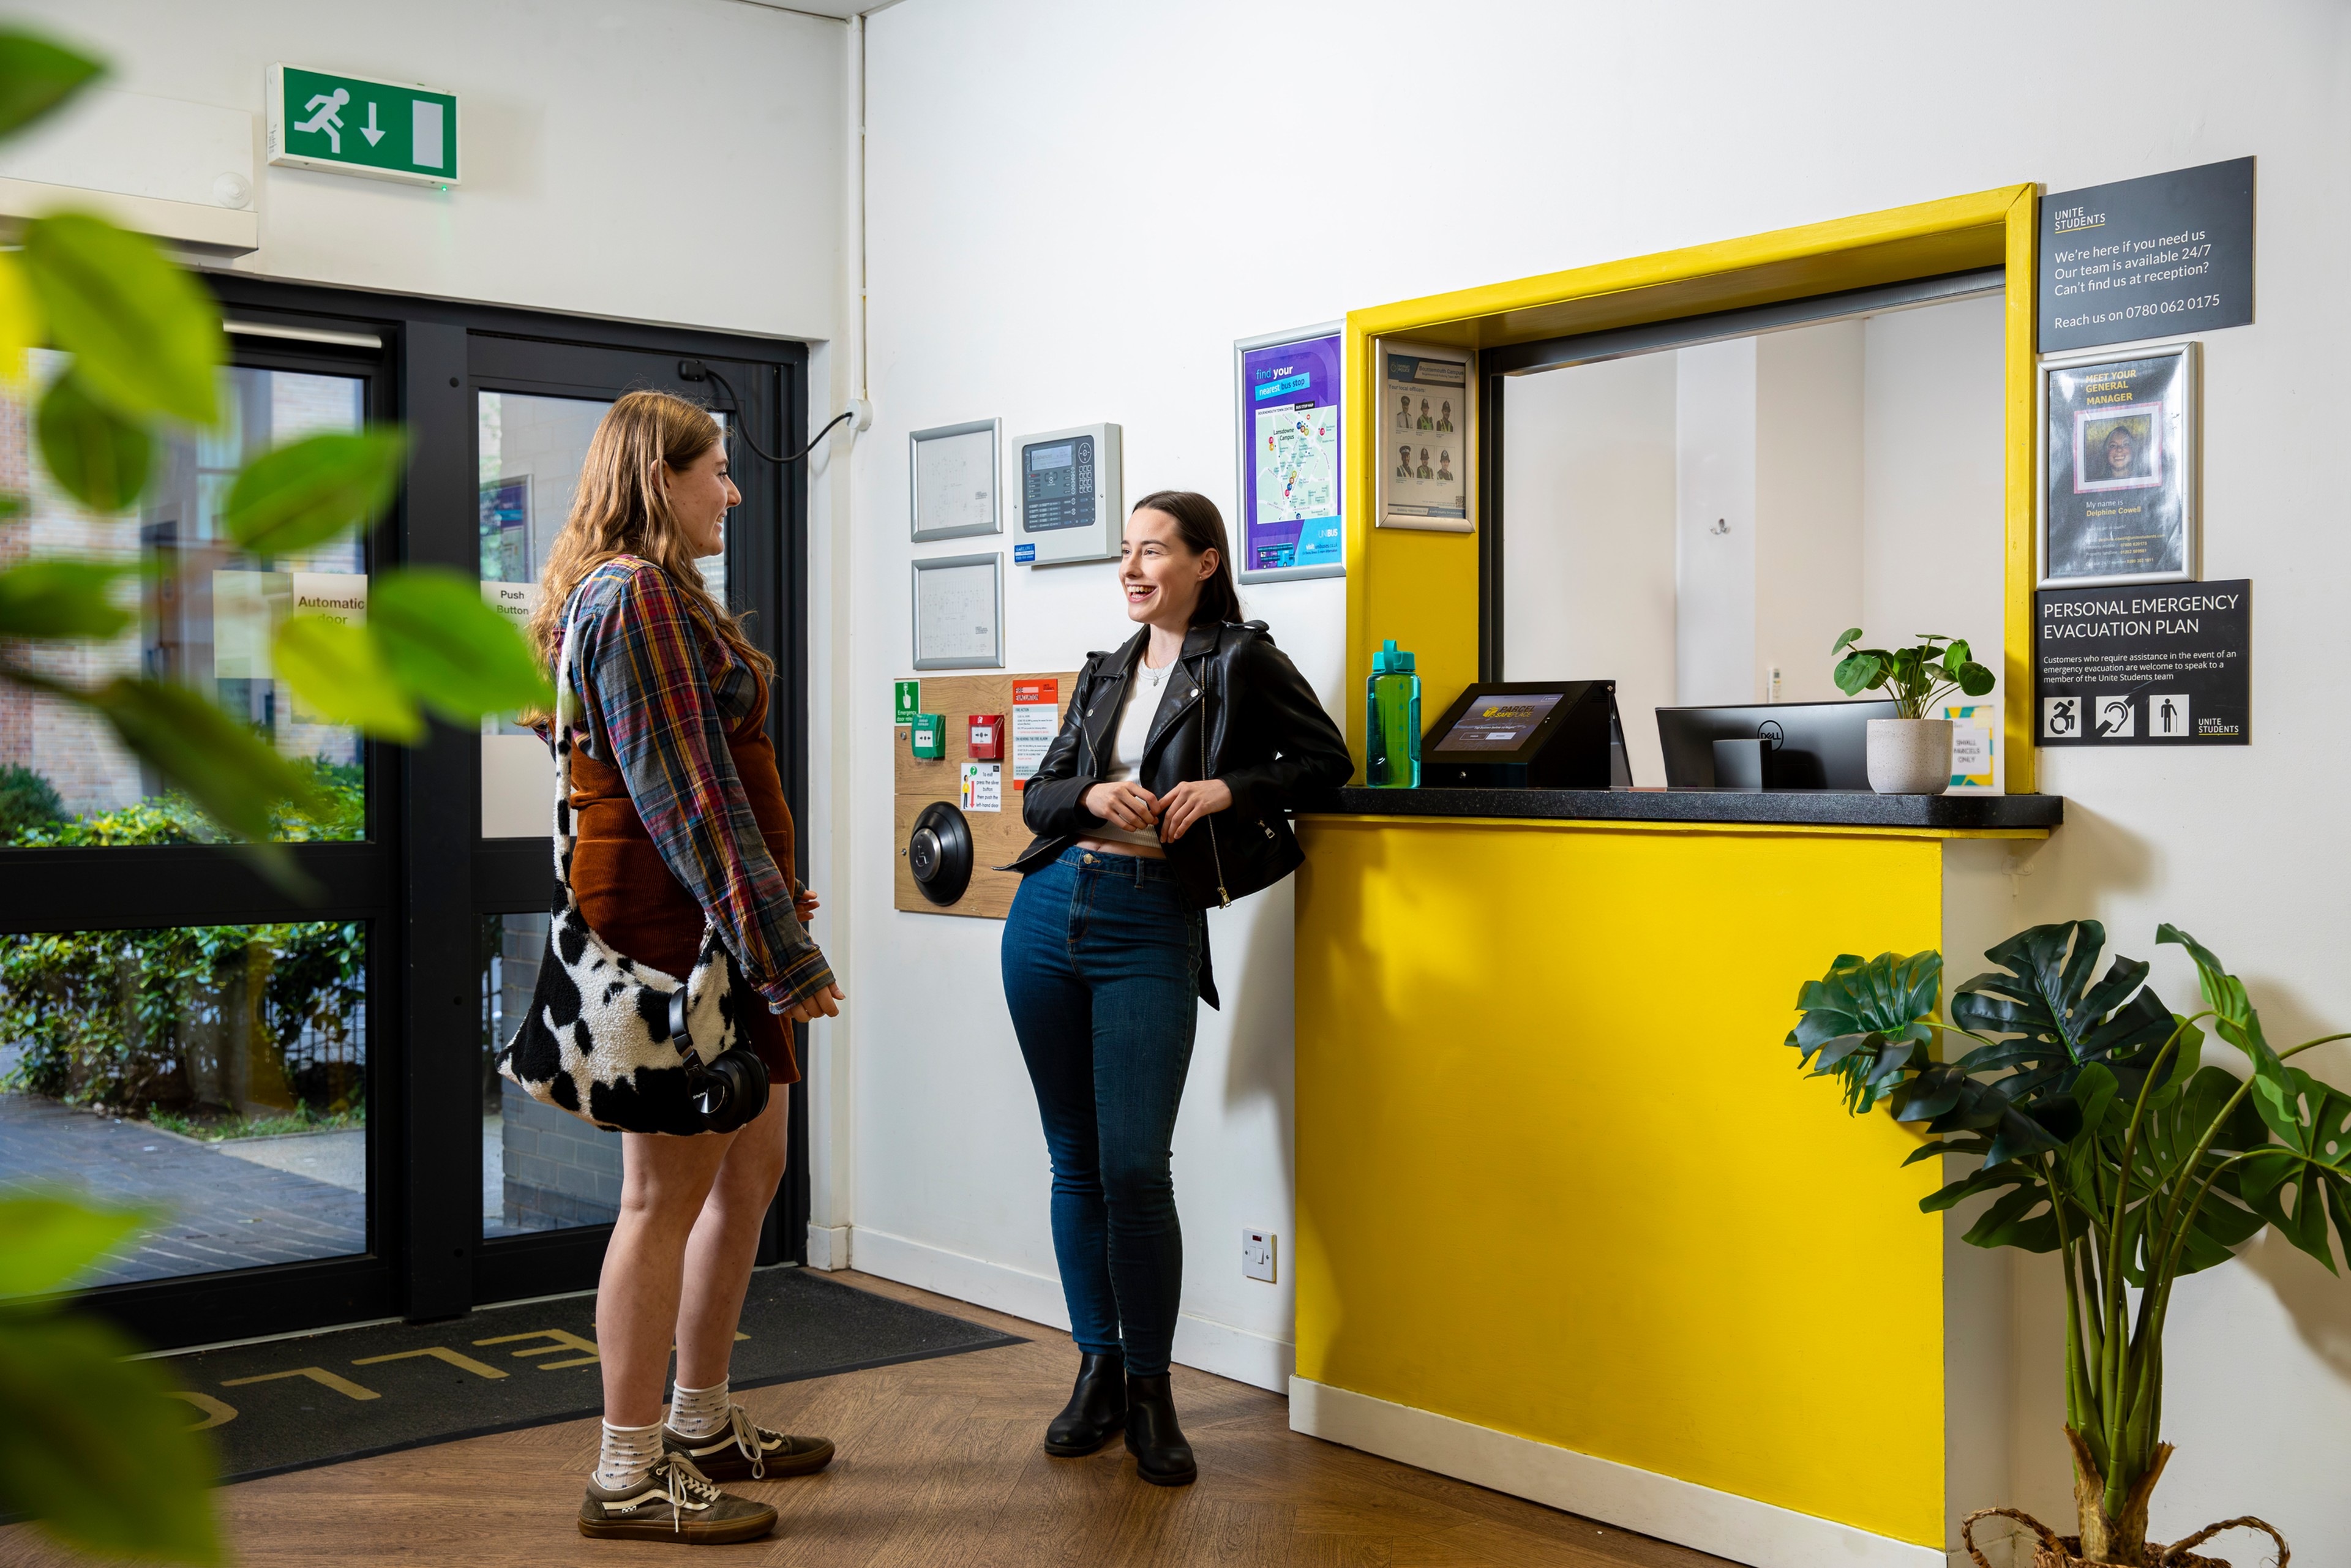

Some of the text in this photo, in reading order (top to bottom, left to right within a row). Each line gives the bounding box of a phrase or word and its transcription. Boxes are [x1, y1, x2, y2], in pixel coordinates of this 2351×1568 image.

[2055, 207, 2083, 220] UNITE
[2055, 214, 2105, 230] STUDENTS
[2055, 230, 2205, 263] We’re here if you need us
[2055, 244, 2211, 280] Our team is available 24/7
[2055, 262, 2209, 296] Can’t find us at reception?
[2055, 294, 2219, 329] Reach us on 0780 062 0175
[1256, 366, 1293, 380] find your
[2087, 370, 2136, 383] MEET YOUR
[1260, 384, 1280, 396] nearest
[2087, 381, 2128, 392] GENERAL
[2087, 392, 2132, 405] MANAGER
[1318, 529, 1338, 538] UNIBUS
[501, 590, 524, 599] Push
[298, 596, 365, 610] Automatic
[2044, 595, 2238, 617] PERSONAL EMERGENCY
[497, 606, 529, 615] Button
[317, 614, 348, 625] door
[2044, 619, 2199, 639] EVACUATION PLAN
[2101, 654, 2128, 663] require
[2044, 666, 2083, 675] emergency
[2184, 661, 2207, 670] speak
[160, 1322, 752, 1433] ELLO
